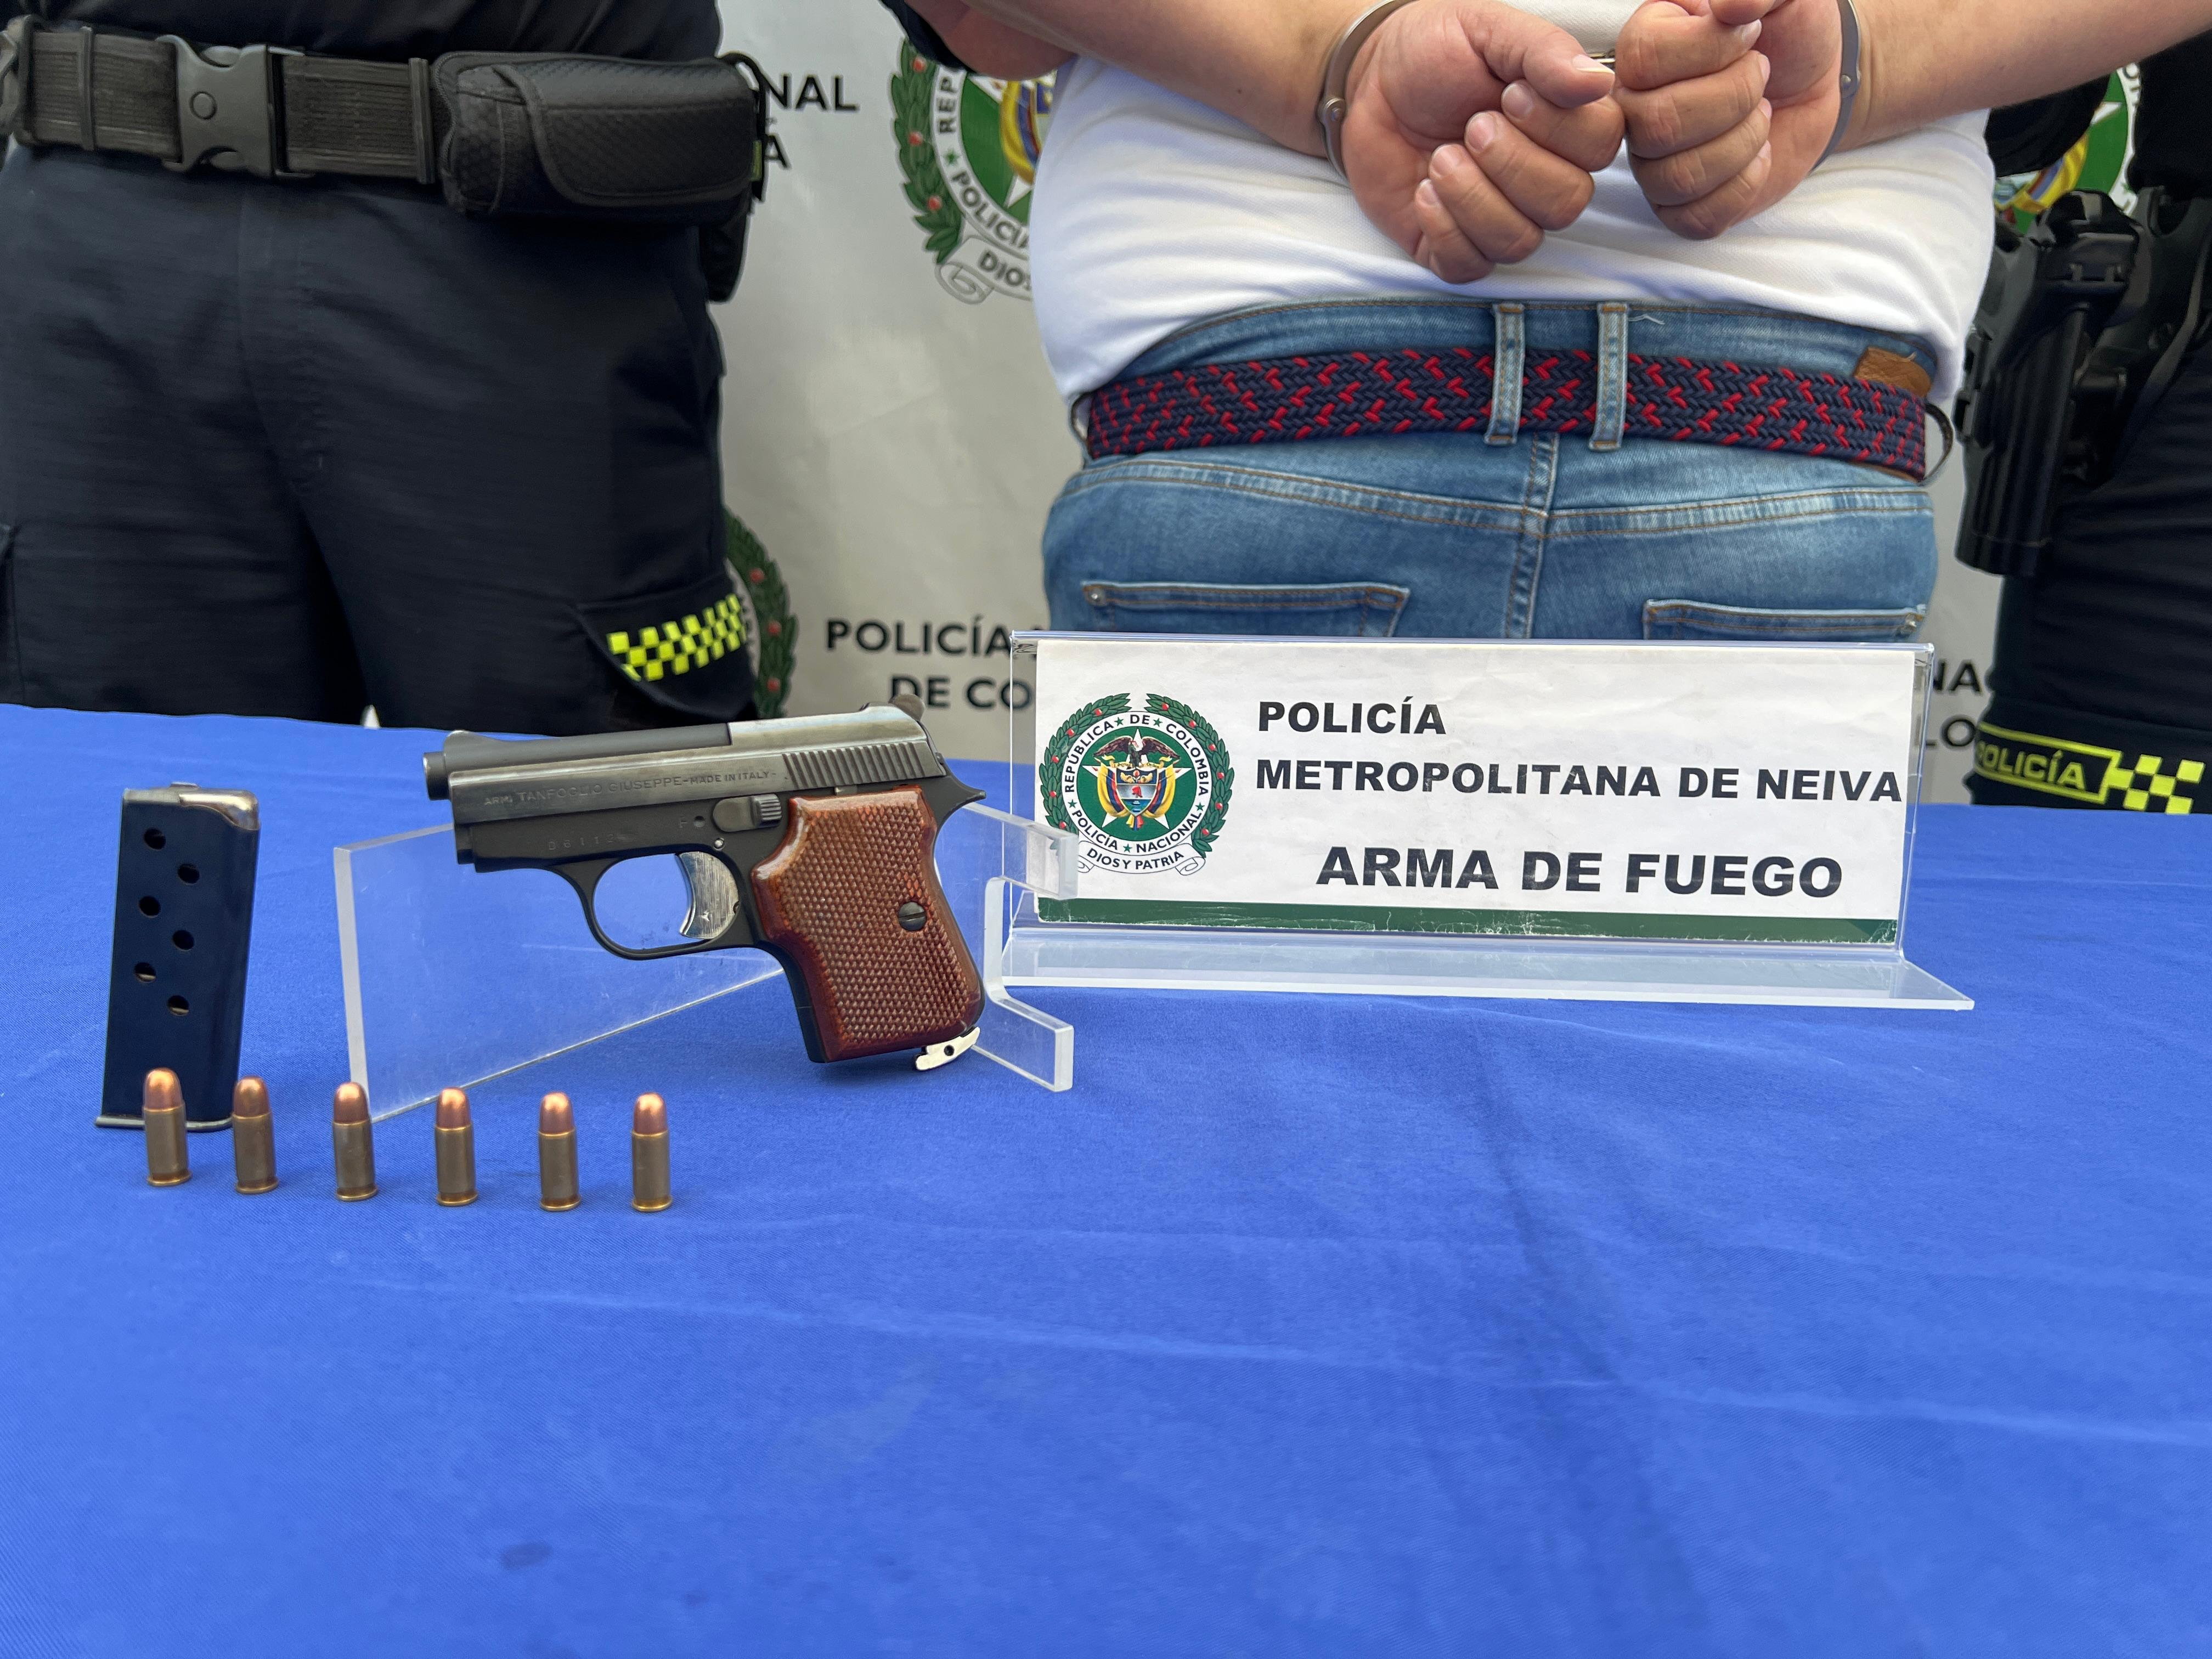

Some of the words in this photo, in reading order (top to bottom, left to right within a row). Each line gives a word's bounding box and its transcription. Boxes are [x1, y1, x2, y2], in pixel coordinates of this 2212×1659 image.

[827, 614, 1012, 657] POLICÍA
[1259, 696, 1446, 735] POLICÍA
[1064, 720, 1114, 793] REPÚBLICA
[1130, 714, 1150, 725] DE
[1166, 723, 1209, 796] COLOMBIA
[517, 785, 603, 802] TANFOGLIO
[1256, 759, 1661, 798] METROPOLITANA
[1679, 767, 1740, 799] DE
[1757, 769, 1903, 802] NEIVA
[1071, 809, 1118, 850] POLICÍA
[1136, 810, 1201, 853] NACIONAL
[1086, 848, 1120, 868] DIOS
[1121, 859, 1132, 870] Y
[1135, 850, 1184, 870] PATRIA
[1316, 846, 1499, 890] ARMA
[1521, 851, 1602, 892] DE
[1624, 853, 1843, 898] FUEGO
